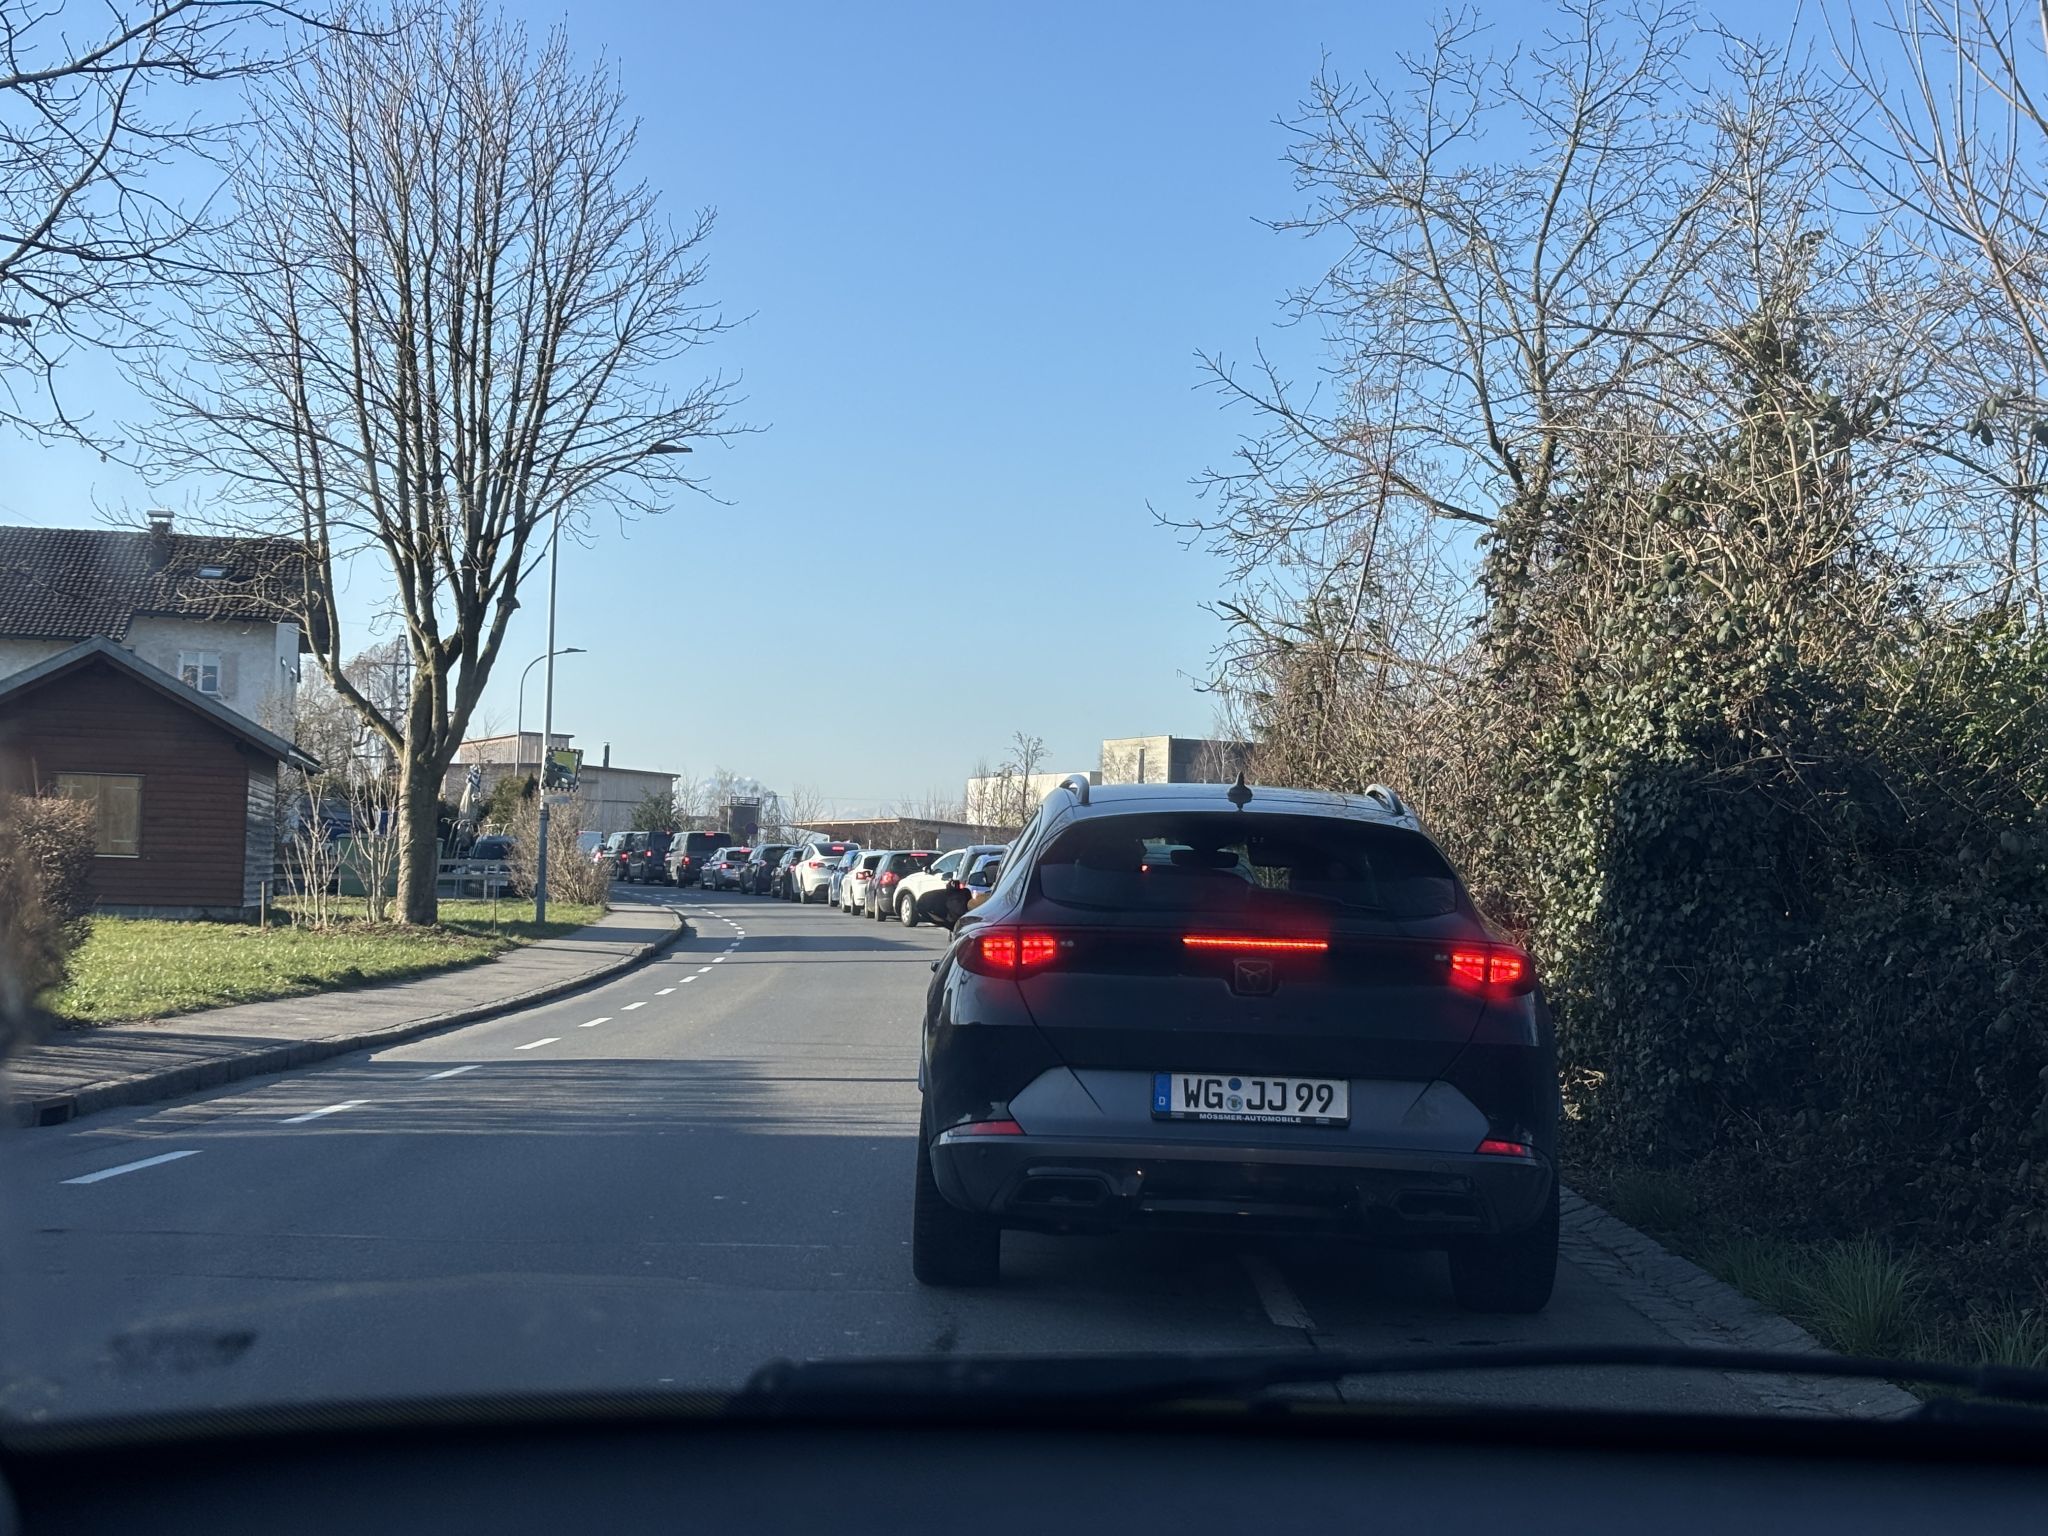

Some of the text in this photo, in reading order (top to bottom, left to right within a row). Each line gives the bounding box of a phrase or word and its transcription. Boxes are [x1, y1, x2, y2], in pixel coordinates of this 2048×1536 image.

[1159, 1096, 1166, 1105] D
[1183, 1078, 1333, 1113] WG JJ 99
